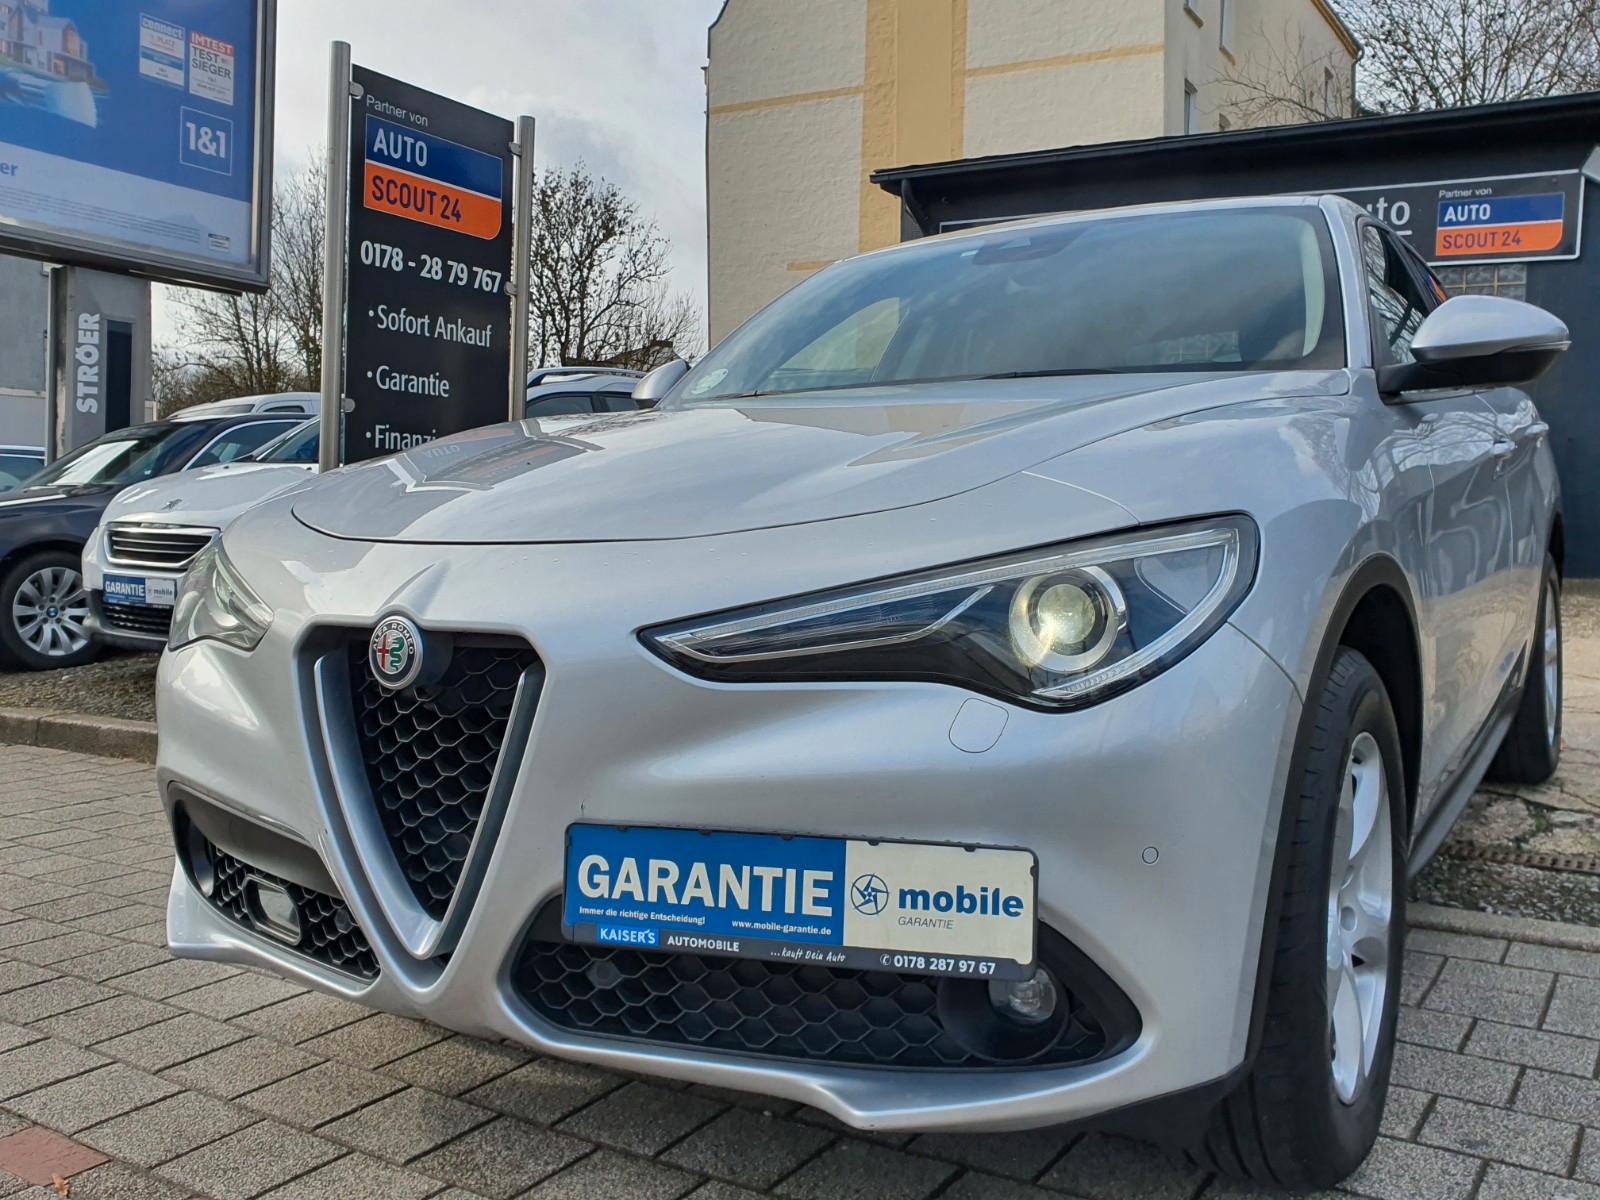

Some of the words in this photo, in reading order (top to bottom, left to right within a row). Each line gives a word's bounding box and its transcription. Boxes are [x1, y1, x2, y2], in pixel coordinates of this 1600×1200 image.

[192, 45, 219, 63] TEST
[192, 58, 231, 79] SIEGER
[366, 94, 406, 119] Partner
[409, 113, 429, 127] von
[186, 122, 226, 159] 1&1
[373, 128, 428, 167] AUTO
[1438, 190, 1472, 199] Partner
[1475, 187, 1493, 195] von
[1366, 196, 1410, 226] to
[1444, 204, 1491, 222] AUTO
[360, 240, 403, 272] 0178
[419, 254, 443, 280] 28
[447, 260, 468, 286] 79
[472, 266, 502, 293] 767
[377, 304, 430, 337] Sofort
[434, 316, 492, 348] Ankauf
[75, 312, 100, 414] STRÖER
[376, 365, 449, 398] Garantie
[105, 581, 145, 596] GARANTIE
[373, 626, 388, 650] ALFA
[391, 623, 414, 655] ROMEO
[577, 854, 834, 917] GARANTIE
[899, 885, 1024, 917] mobile
[579, 906, 604, 915] Immer
[606, 908, 618, 917] die
[619, 909, 649, 921] richtige
[650, 912, 706, 926] Entscheidung!
[732, 920, 832, 936] www.mobile-garantie.de
[898, 916, 954, 930] GARANTIE
[667, 935, 740, 952] AUTOMOBILE
[805, 949, 823, 960] Dein
[826, 952, 846, 962] Auto
[893, 955, 925, 969] 0178
[929, 957, 954, 972] 287
[958, 960, 976, 973] 97
[978, 962, 996, 975] 67
